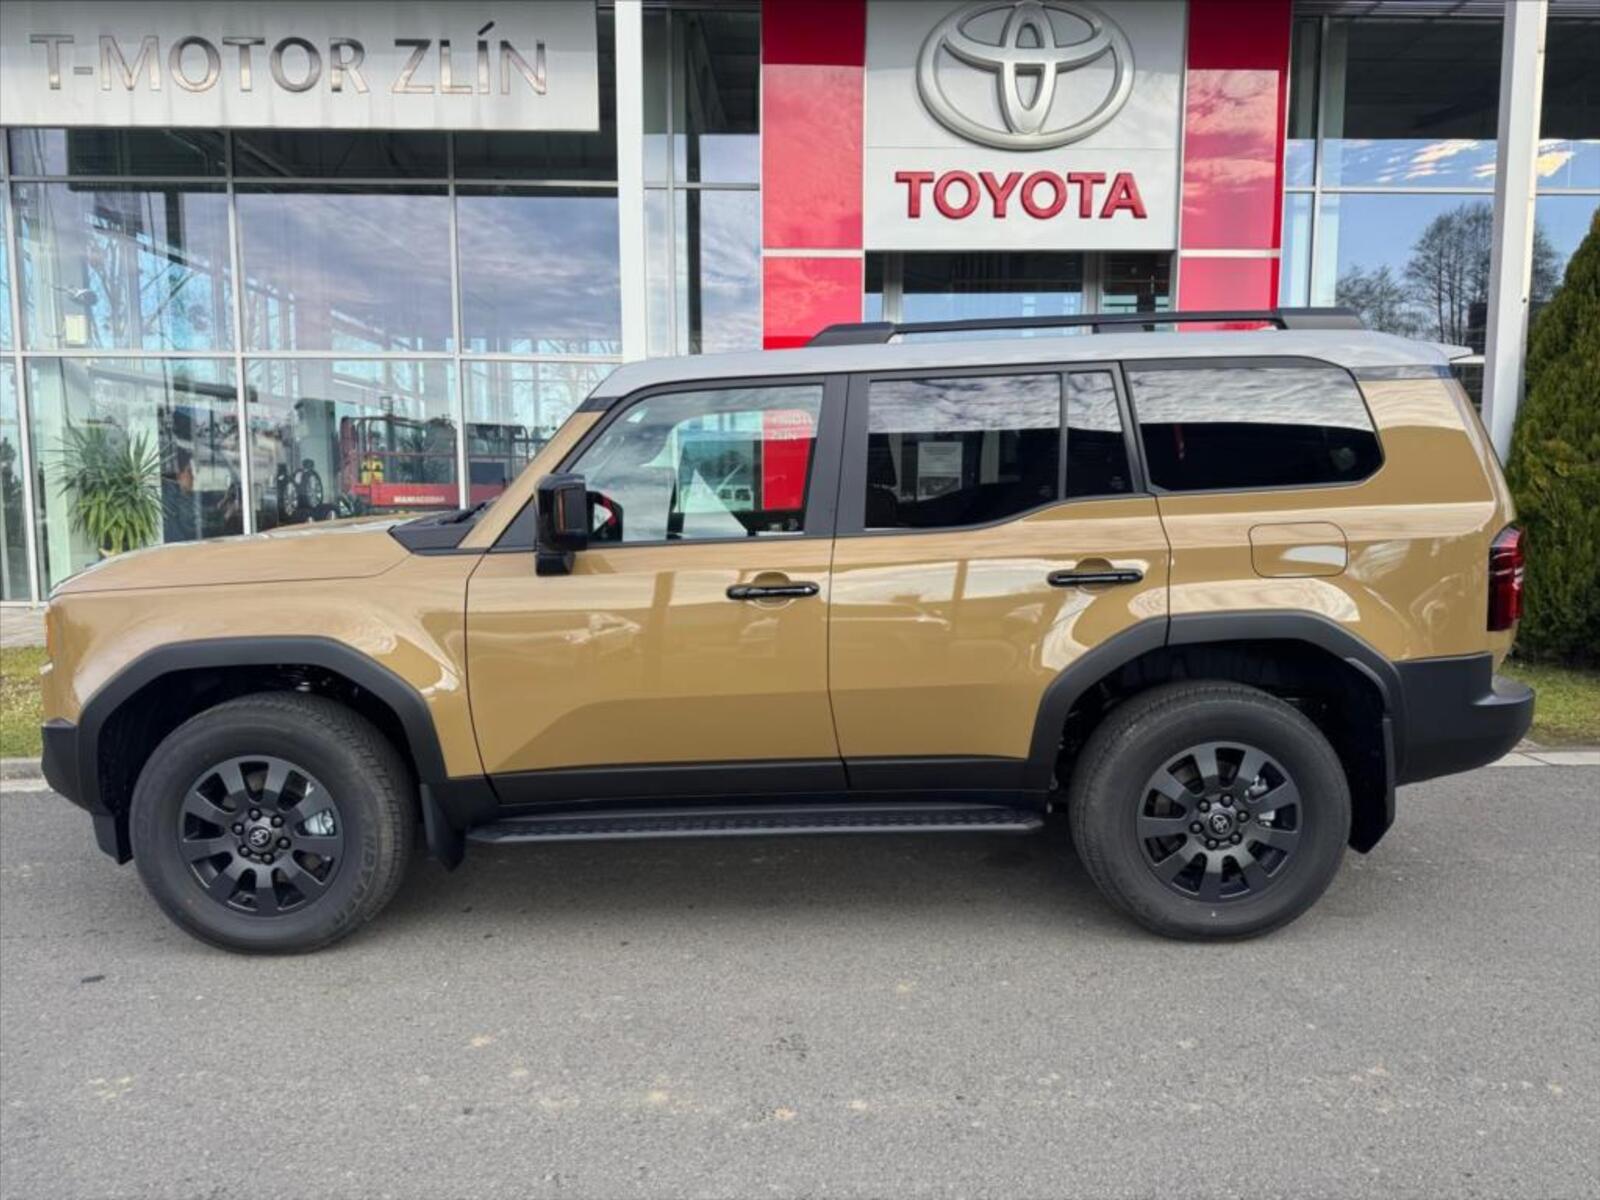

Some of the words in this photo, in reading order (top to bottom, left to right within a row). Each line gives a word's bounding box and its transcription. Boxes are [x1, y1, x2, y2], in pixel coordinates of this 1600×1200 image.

[30, 34, 369, 93] T-MOTOR
[391, 21, 547, 95] ZLÍN
[895, 170, 1147, 220] TOYOTA
